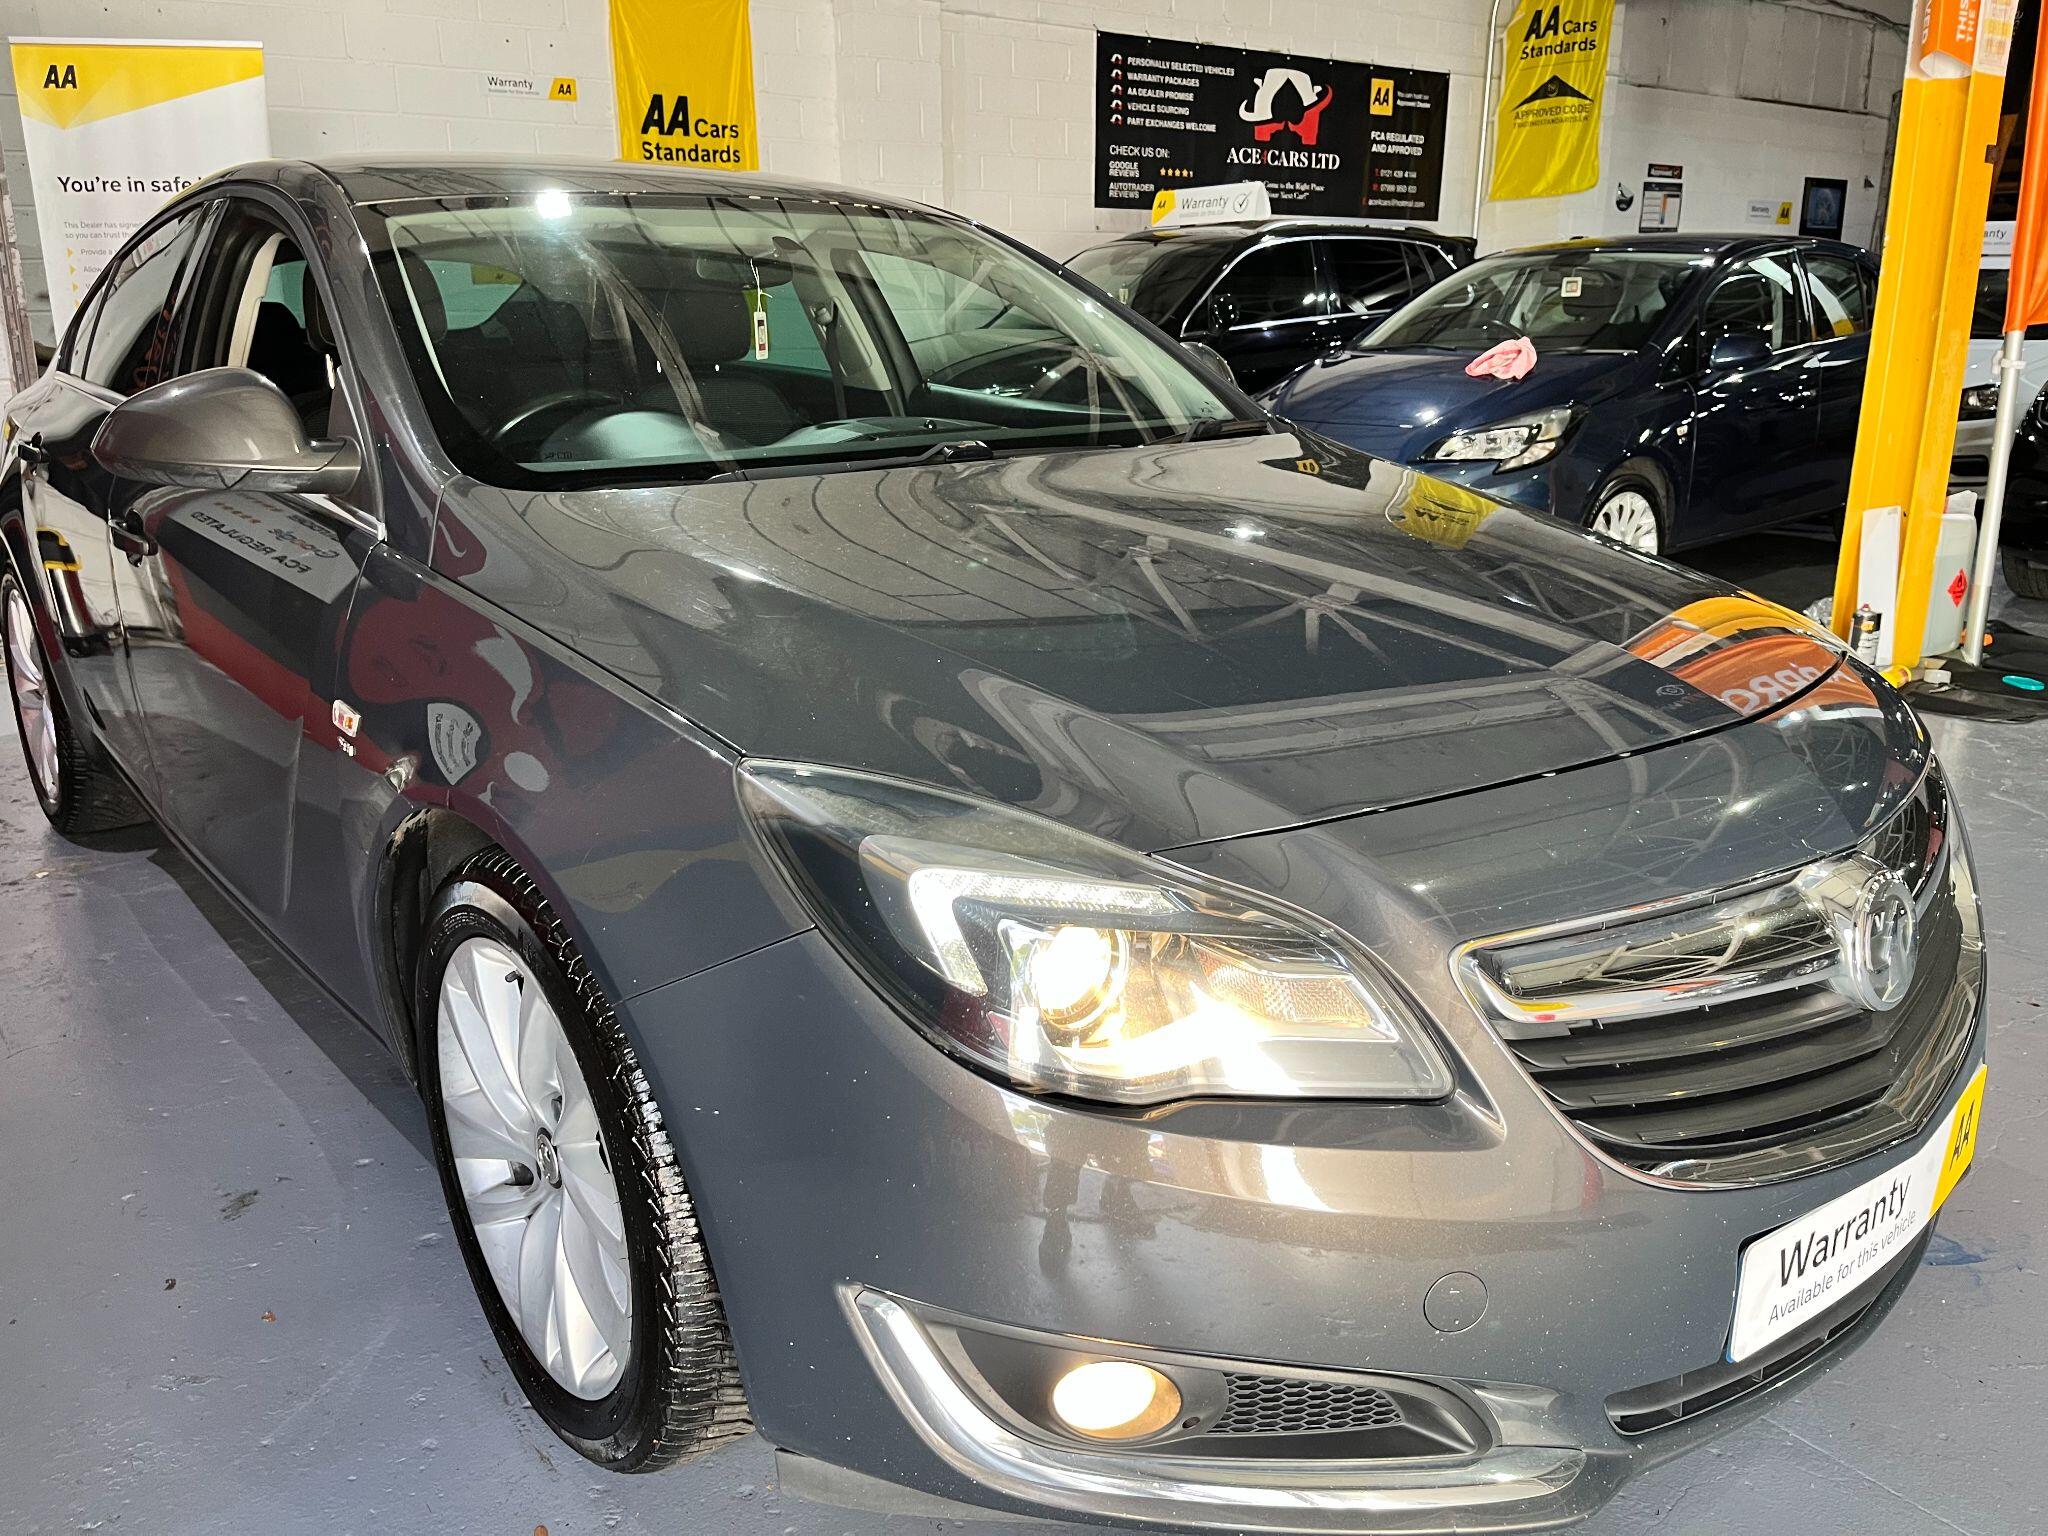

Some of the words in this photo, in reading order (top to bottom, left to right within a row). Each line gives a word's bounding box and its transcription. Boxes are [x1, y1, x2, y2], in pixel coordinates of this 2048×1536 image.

[1523, 5, 1560, 42] AA
[1562, 20, 1598, 36] Cars
[1520, 37, 1597, 60] Standards
[1127, 56, 1170, 69] PERSONALLY
[1204, 65, 1235, 77] VEHICLES
[43, 65, 77, 89] AA
[487, 76, 534, 90] Warranty
[1127, 72, 1164, 84] WARRANTY
[1164, 75, 1200, 88] PACKAGES
[557, 83, 572, 96] AA
[1138, 88, 1164, 98] DEALER
[1373, 87, 1390, 106] AA
[640, 93, 690, 137] AA
[694, 119, 739, 139] Cars
[1127, 102, 1156, 112] VEHICLE
[1157, 104, 1190, 116] SOURCING
[1563, 102, 1592, 115] CODE
[1127, 116, 1144, 126] PART
[1145, 118, 1185, 130] EXCHANGES
[1185, 121, 1217, 133] WELCOME
[1371, 131, 1385, 141] FCA
[641, 141, 741, 163] Standards
[1109, 144, 1140, 157] CHECK
[1141, 146, 1154, 158] US
[1109, 160, 1139, 170] GOOGLE
[1311, 152, 1341, 170] LTD
[1109, 168, 1140, 178] REVIEWS
[57, 176, 122, 193] You're
[127, 176, 146, 193] in
[1109, 182, 1155, 192] AUTOTRADER
[1109, 190, 1140, 199] REVIEWS
[1181, 196, 1229, 210] Warranty
[1983, 229, 2007, 241] anty
[1949, 1100, 1976, 1172] AA
[1780, 1173, 1912, 1288] Warranty
[1768, 1272, 1833, 1326] Available
[1836, 1258, 1858, 1285] for
[1857, 1241, 1879, 1268] this
[1881, 1209, 1917, 1252] vehicle
